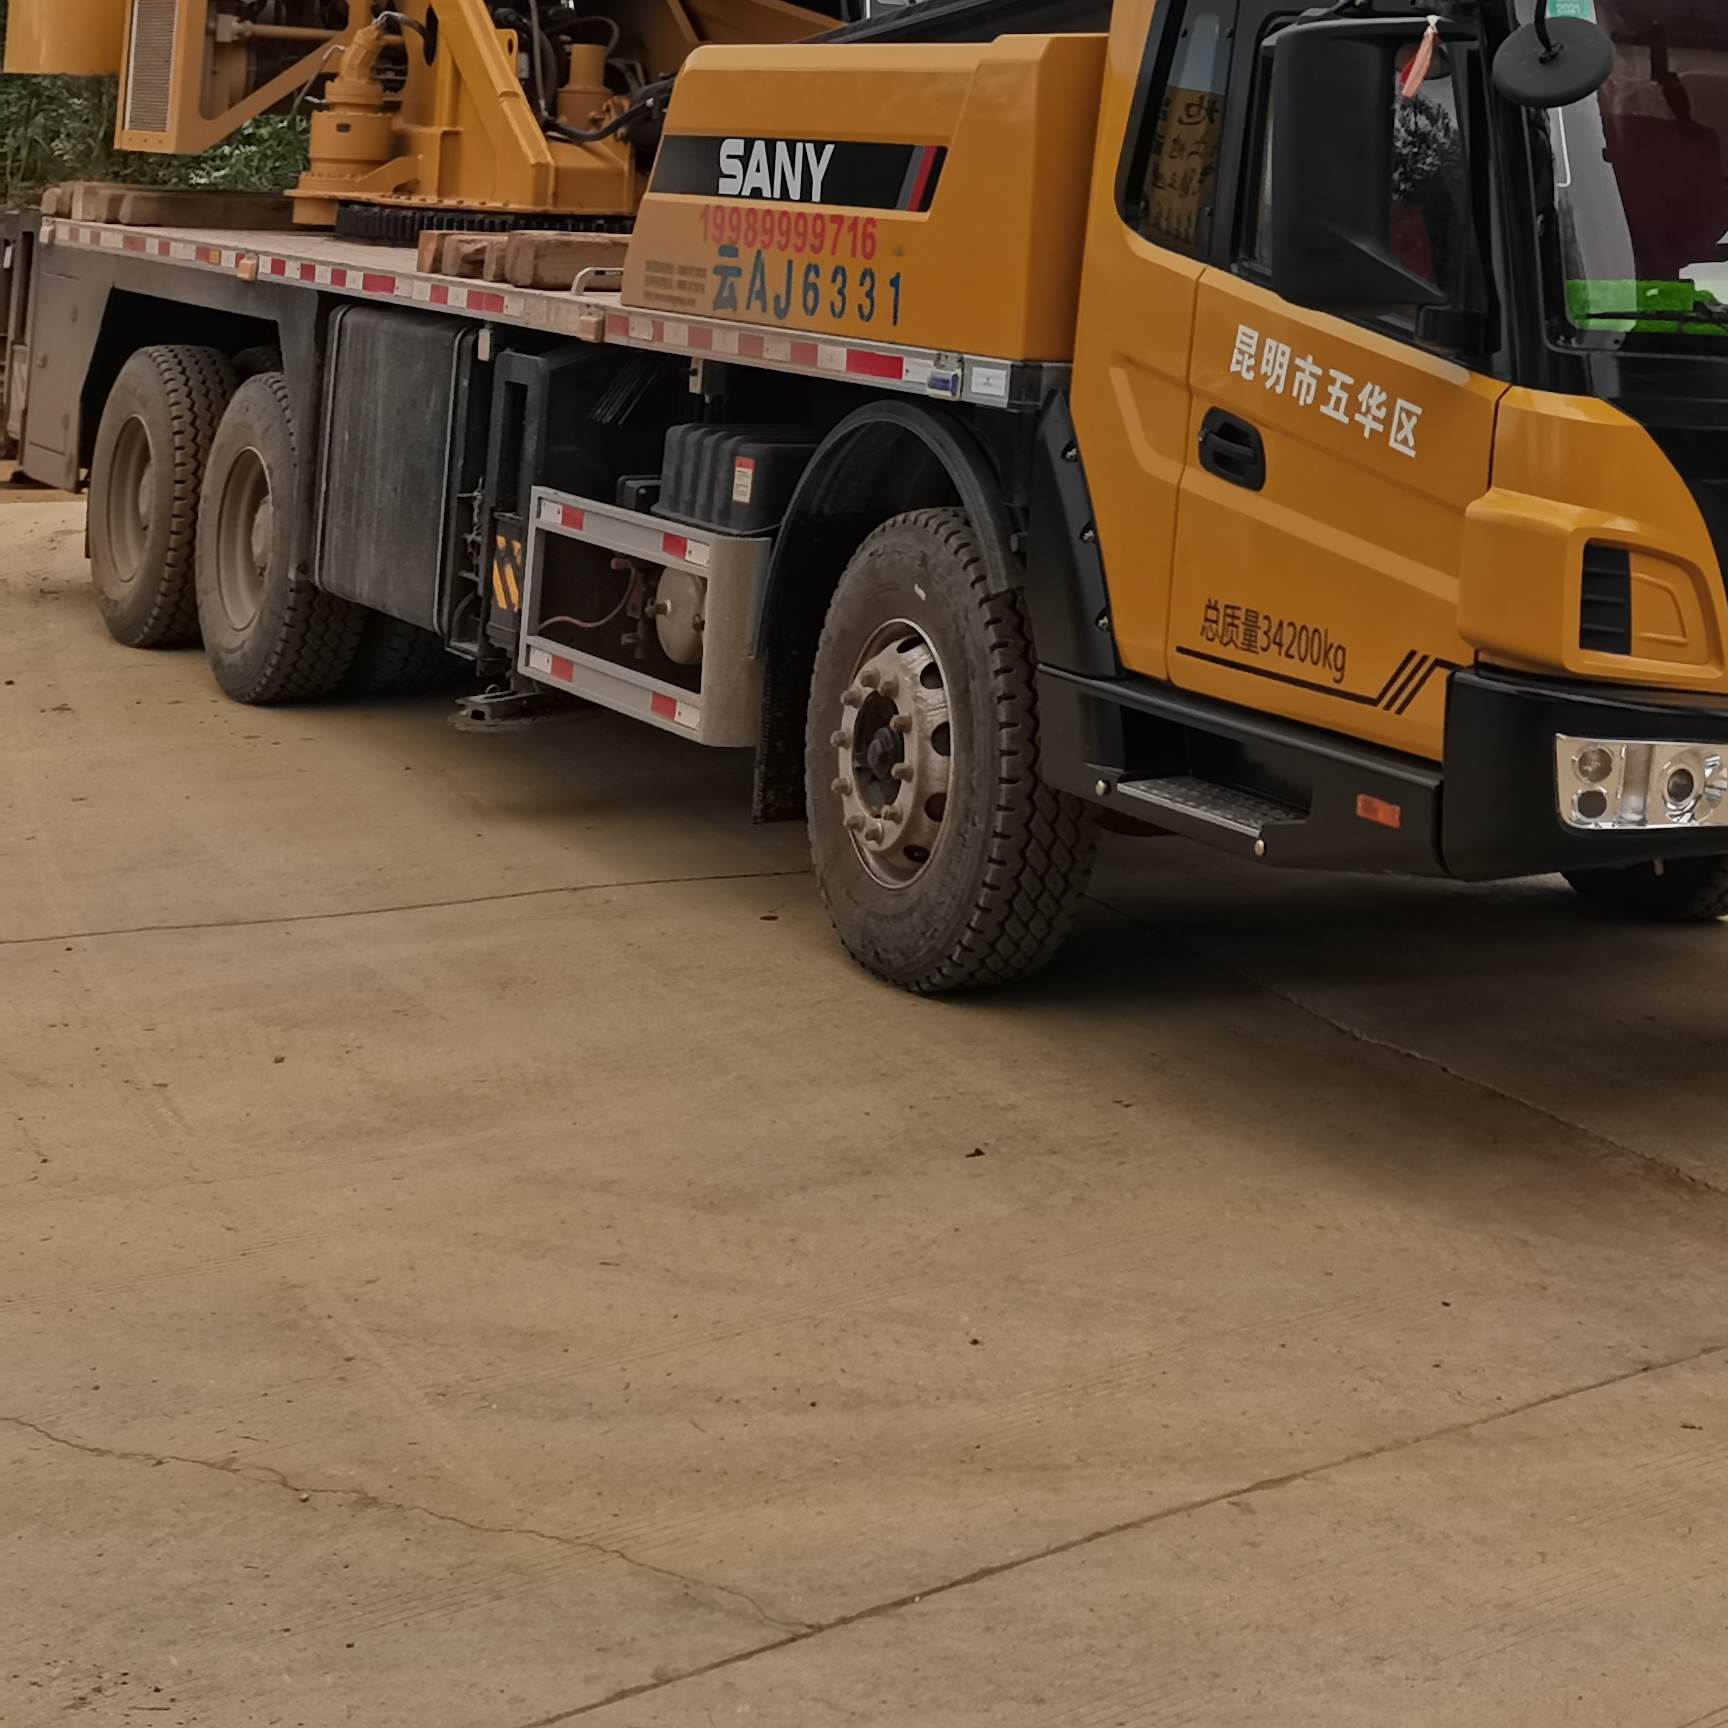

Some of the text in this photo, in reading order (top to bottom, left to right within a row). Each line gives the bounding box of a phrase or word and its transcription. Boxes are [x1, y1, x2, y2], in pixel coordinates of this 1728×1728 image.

[717, 138, 835, 203] SANY
[703, 204, 878, 260] 19989999716
[712, 244, 902, 326] 云AJ6331
[1229, 324, 1424, 458] 昆明市五华区
[1200, 597, 1347, 684] 总质量34200kg
